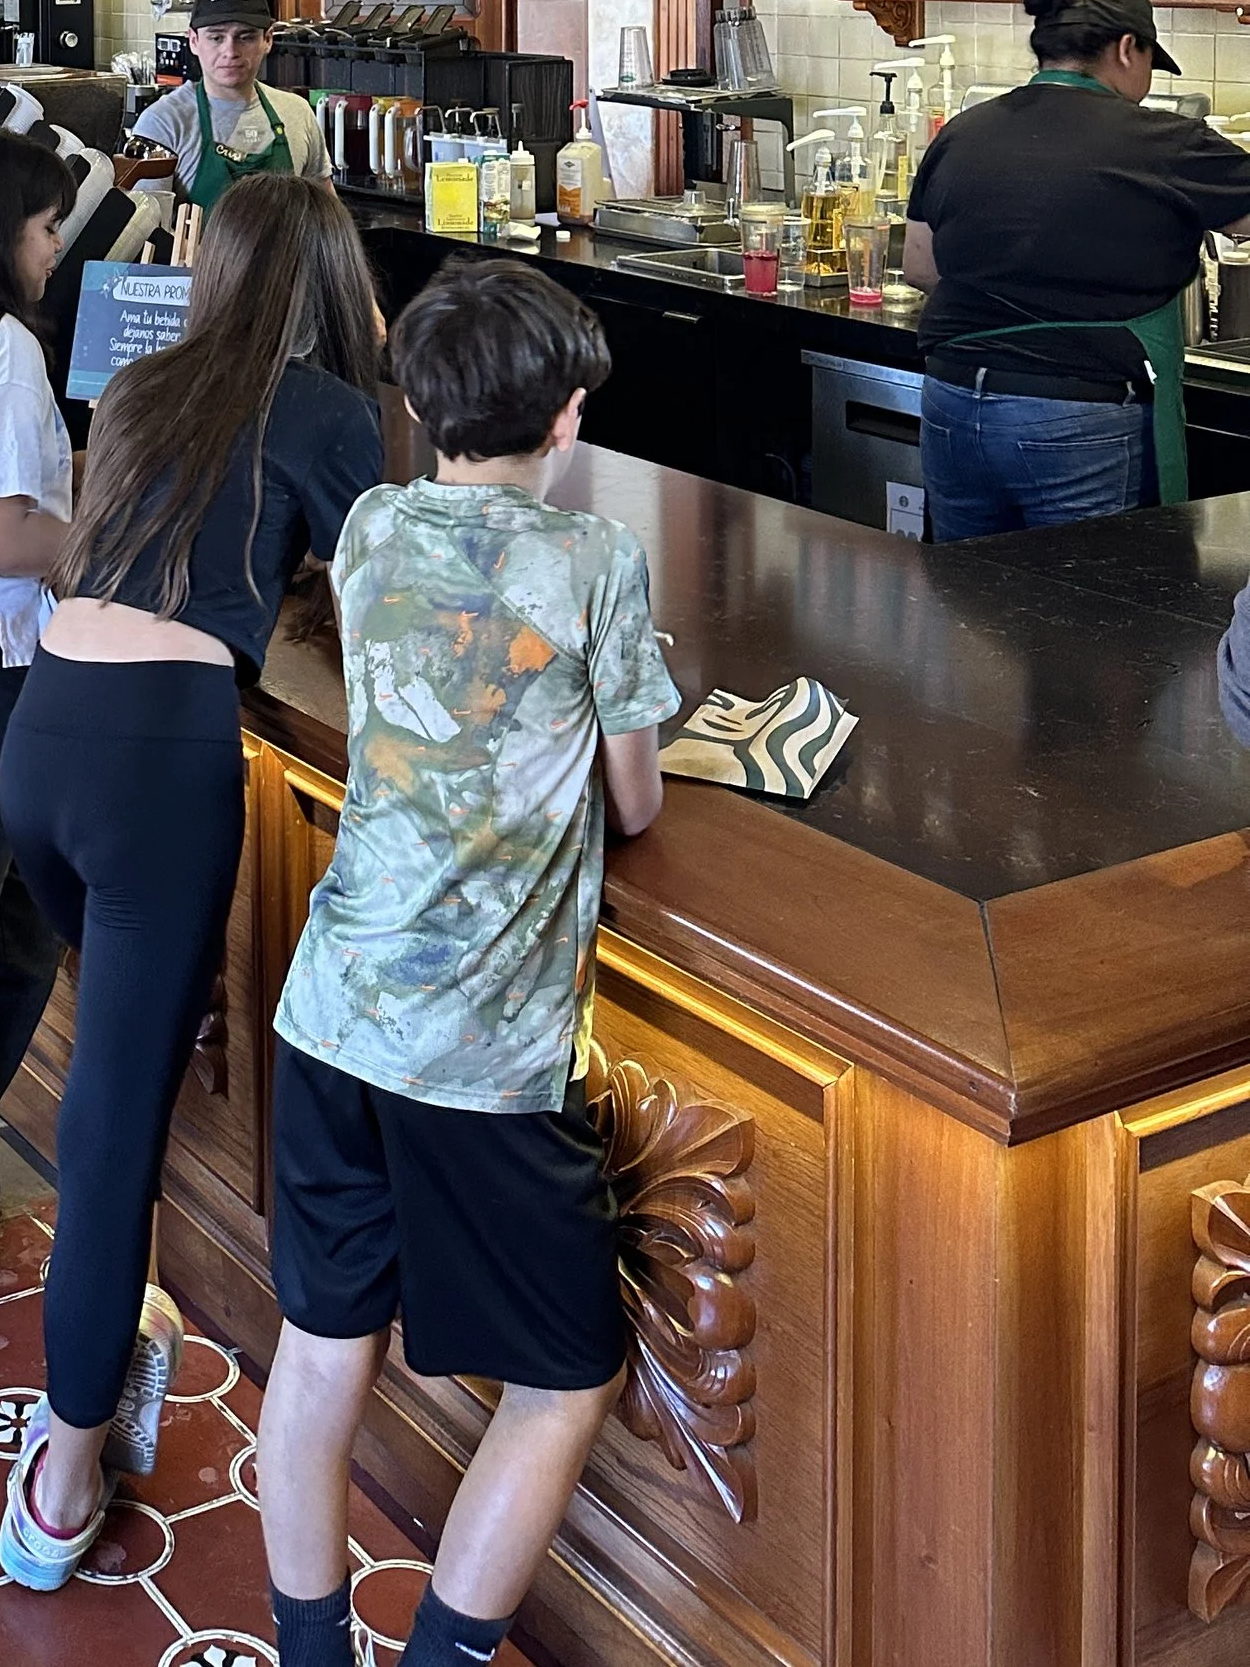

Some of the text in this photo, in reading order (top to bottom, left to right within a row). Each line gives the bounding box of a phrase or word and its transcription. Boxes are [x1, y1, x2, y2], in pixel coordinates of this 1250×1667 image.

[120, 280, 191, 300] NUESTRA PROM
[119, 309, 141, 324] Ama
[143, 309, 152, 325] tu
[154, 310, 181, 327] bebida
[109, 337, 143, 357] Siempre
[144, 339, 153, 354] la
